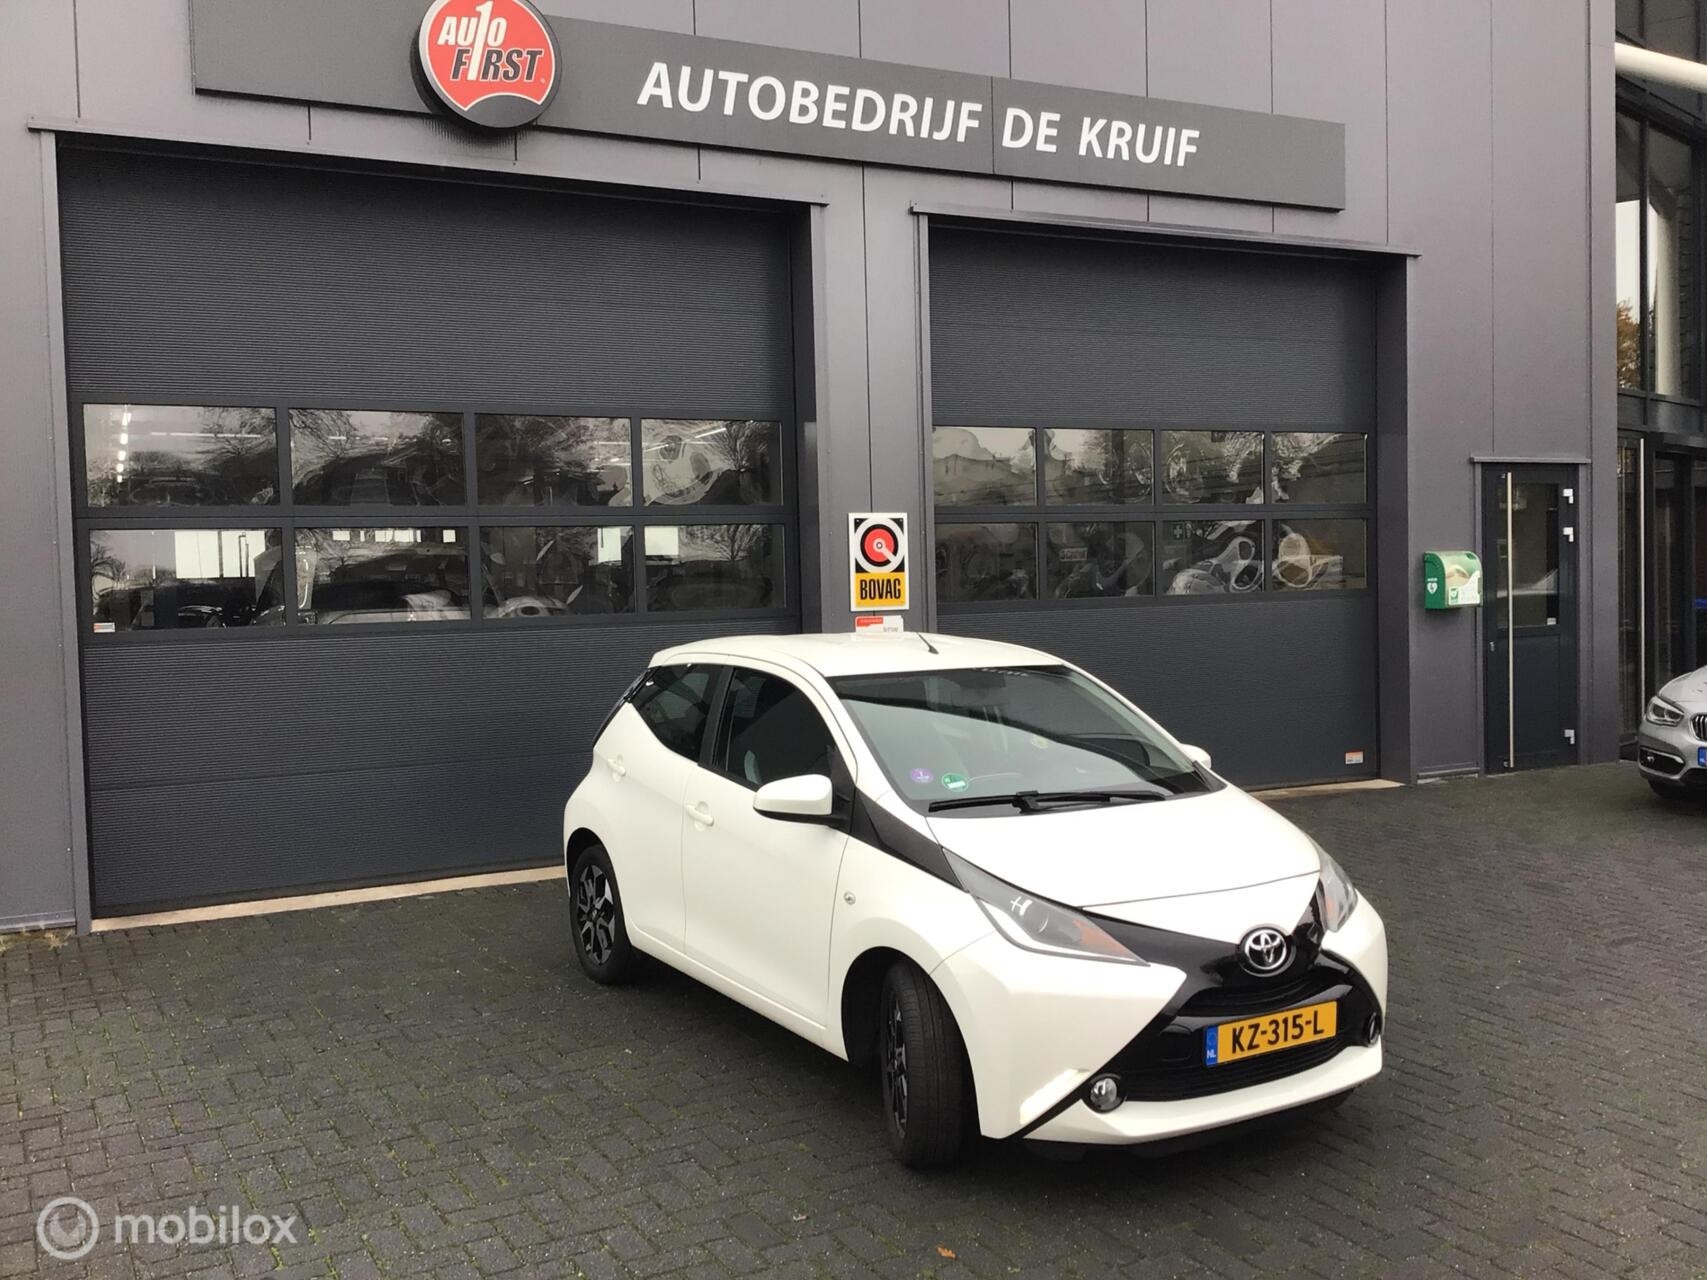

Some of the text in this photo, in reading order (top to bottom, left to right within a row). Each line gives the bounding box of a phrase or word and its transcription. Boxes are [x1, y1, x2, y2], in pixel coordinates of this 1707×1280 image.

[636, 61, 1200, 167] AUTOBEDRIJF DE KRUIF
[860, 578, 901, 600] BOVAG
[1231, 1010, 1324, 1054] KZ-315-L
